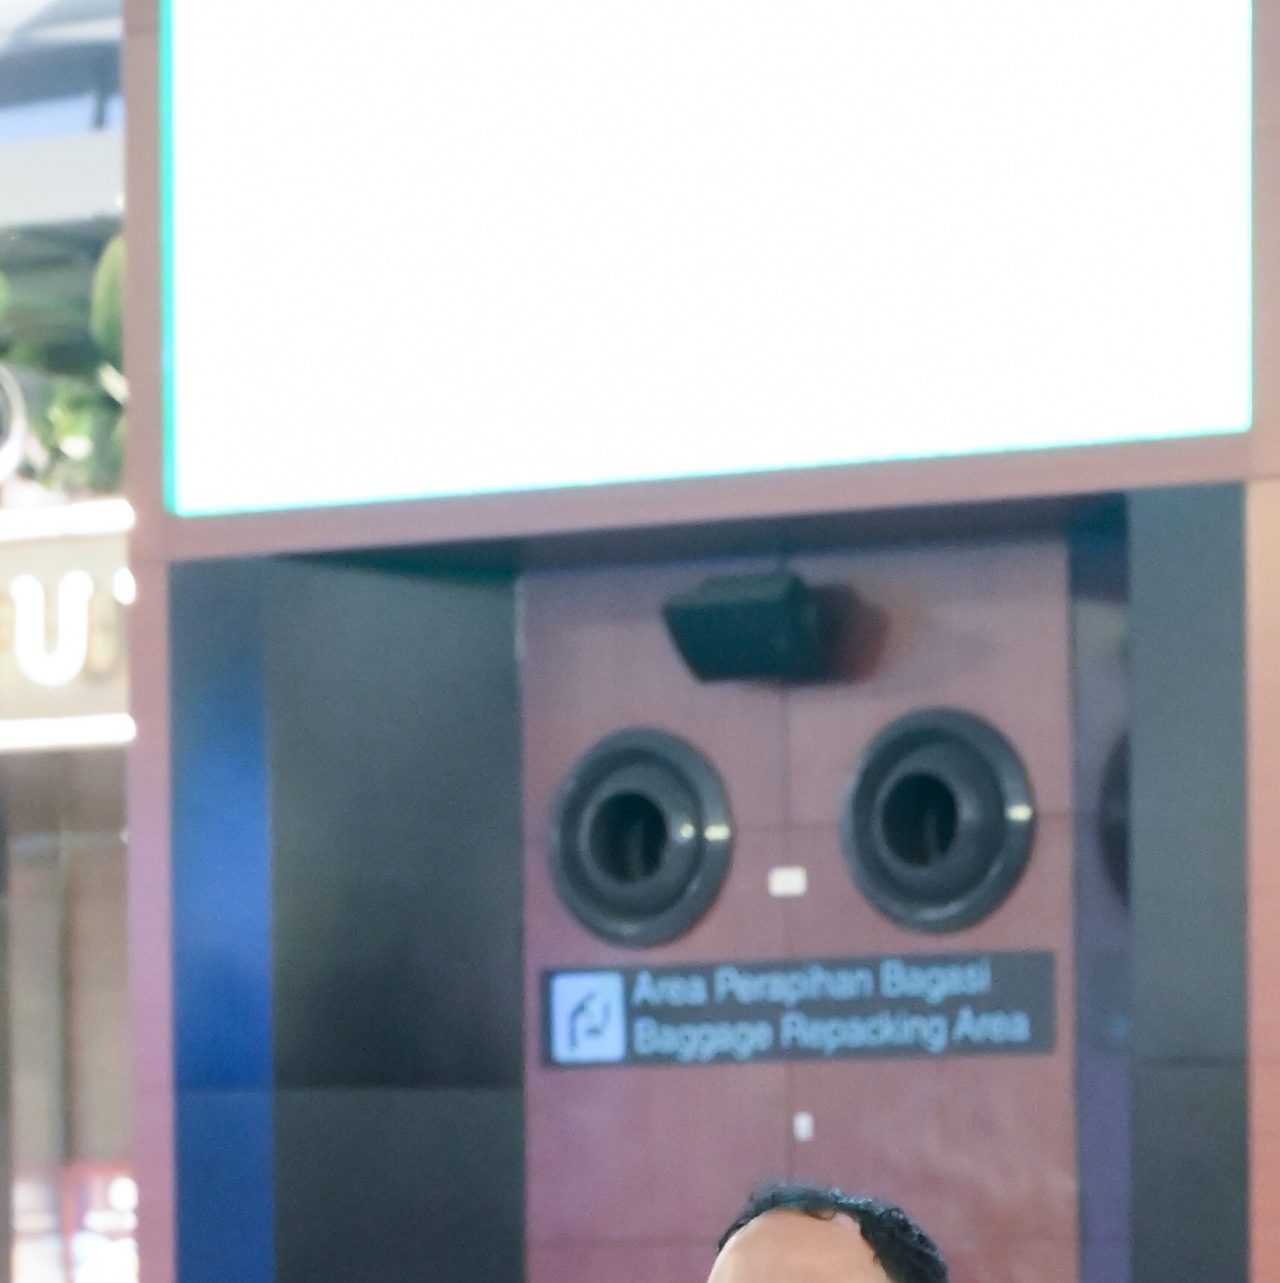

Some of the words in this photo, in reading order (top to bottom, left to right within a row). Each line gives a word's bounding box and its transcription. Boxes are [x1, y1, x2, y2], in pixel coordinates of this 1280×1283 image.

[634, 970, 707, 1006] Area
[880, 957, 991, 1004] Bagasi
[634, 1016, 774, 1062] Baggage
[780, 1011, 949, 1054] Repacking
[952, 1005, 1030, 1044] Area
